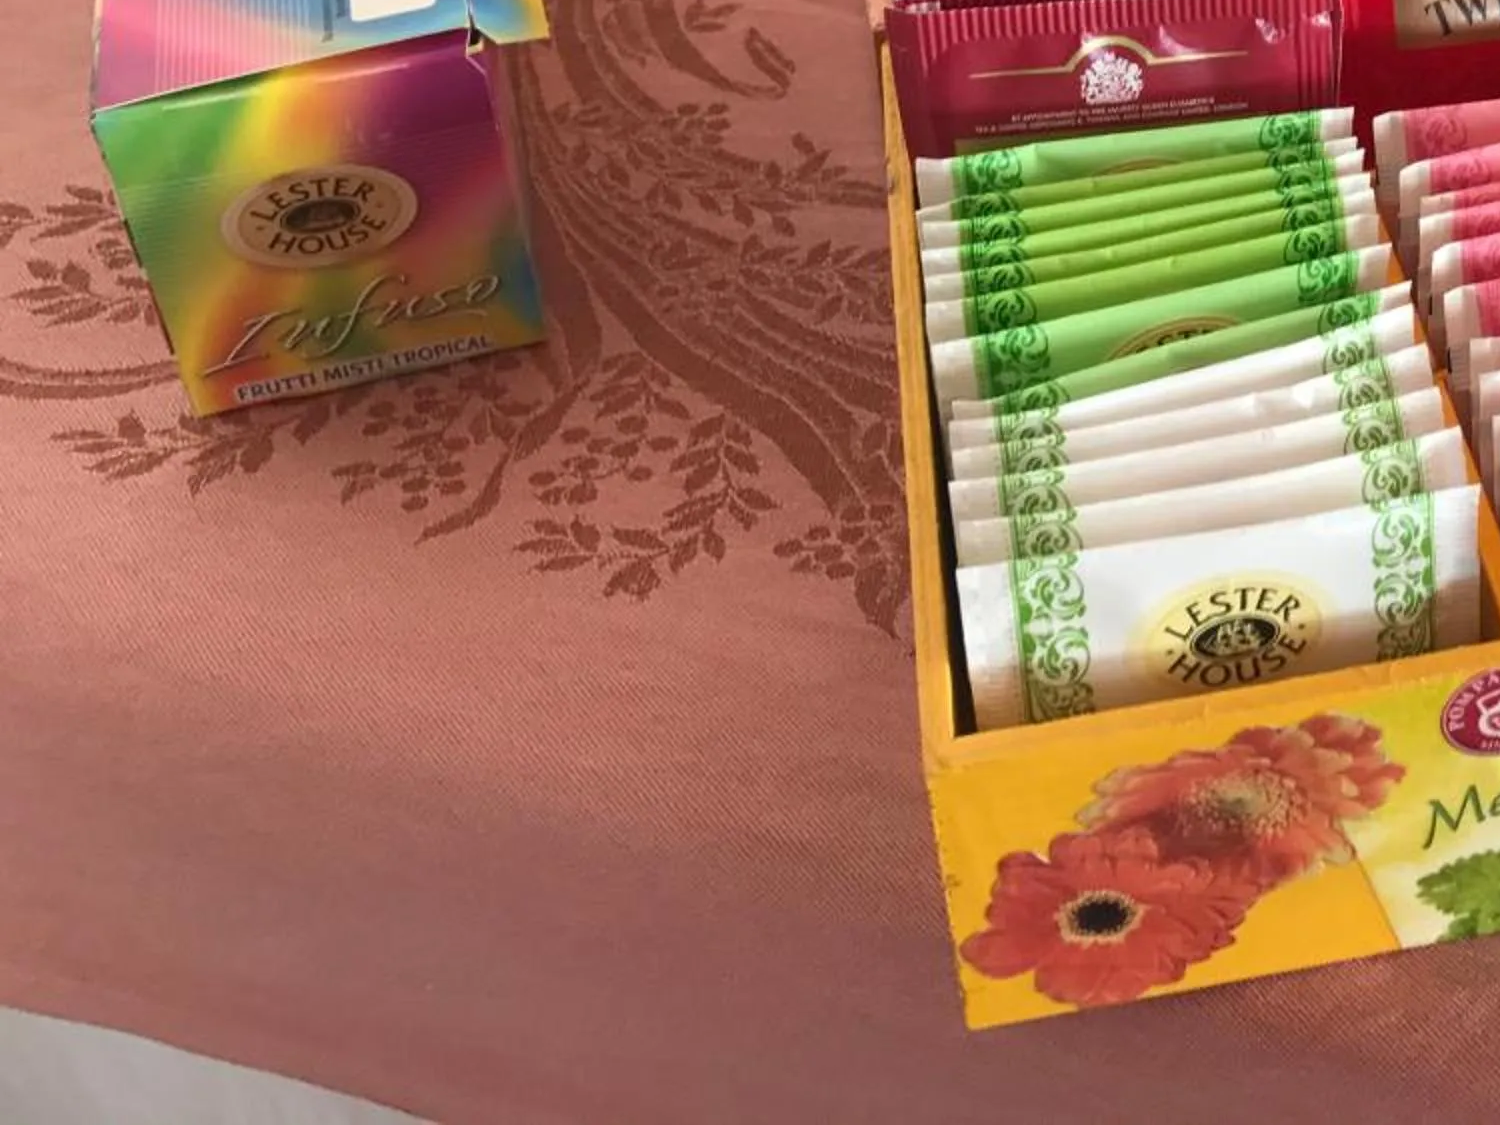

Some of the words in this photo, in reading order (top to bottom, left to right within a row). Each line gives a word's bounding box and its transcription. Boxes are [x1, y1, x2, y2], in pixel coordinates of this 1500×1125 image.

[252, 177, 376, 221] LESTER
[267, 213, 387, 255] HOUSE
[202, 275, 499, 378] Infuso
[236, 371, 317, 401] FRUTTI
[322, 360, 385, 382] MISTI
[392, 335, 493, 367] TROPICAL
[1164, 586, 1301, 642] LESTER
[1167, 632, 1308, 688] HOUSE
